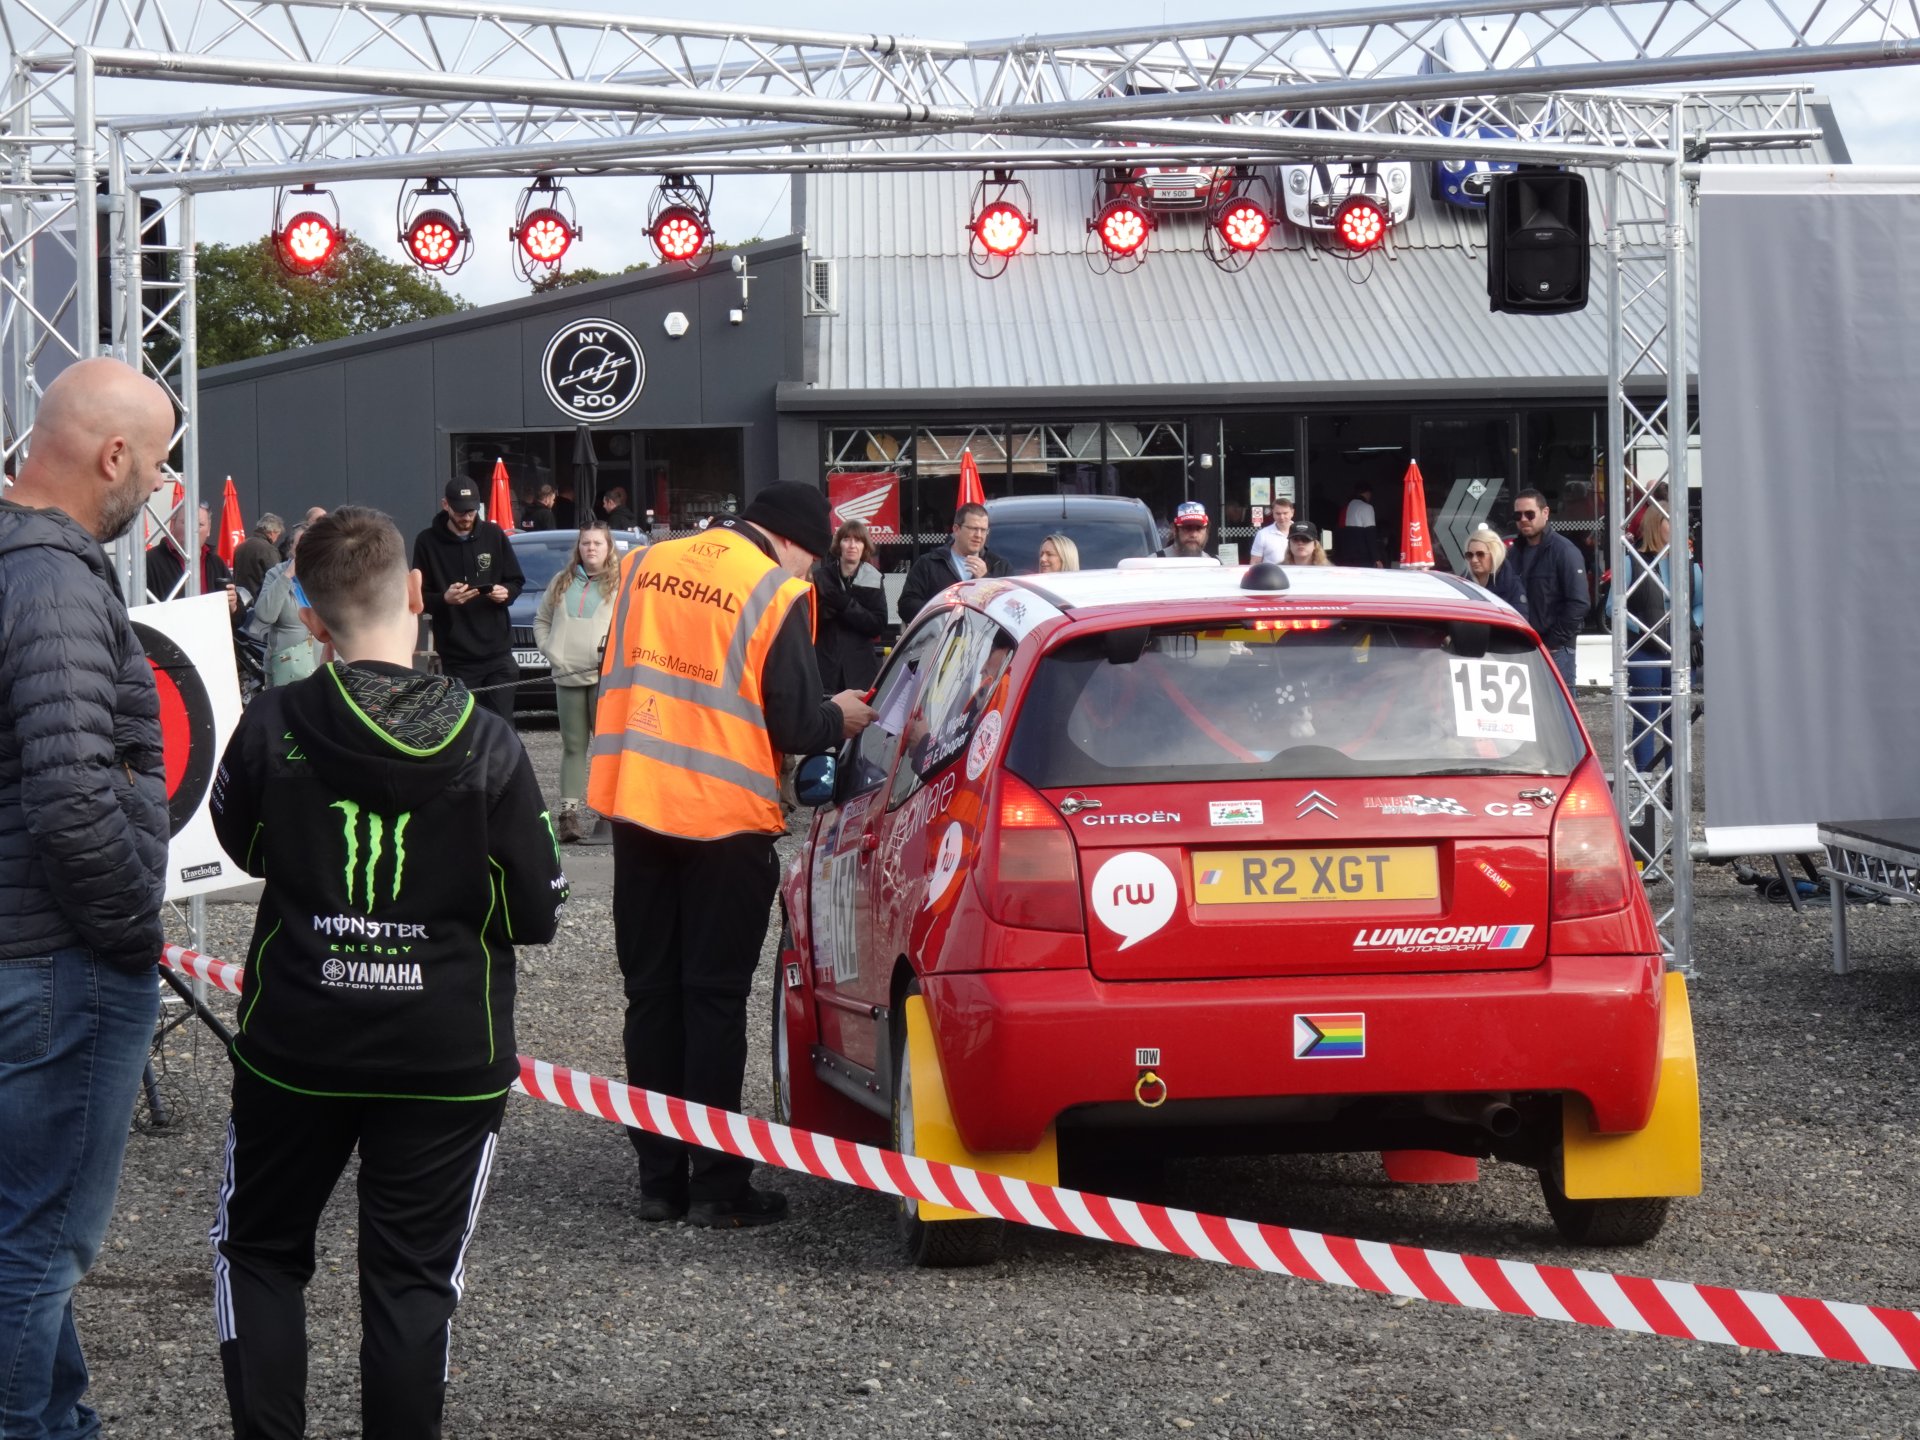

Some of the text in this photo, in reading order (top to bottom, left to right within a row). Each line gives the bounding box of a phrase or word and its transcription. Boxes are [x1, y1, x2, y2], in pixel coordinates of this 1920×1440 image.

[579, 332, 607, 343] NY
[573, 395, 616, 407] 500
[635, 572, 736, 614] MARSHAL
[1454, 663, 1530, 716] 152
[1484, 802, 1533, 816] C2
[1082, 811, 1181, 826] CITROËN
[182, 866, 220, 879] Travelodge
[1242, 855, 1390, 895] R2 XGT
[1113, 883, 1155, 906] rw
[313, 914, 429, 939] MONSTER
[1353, 926, 1498, 946] LUNICORN
[330, 944, 411, 955] ENERGY
[1394, 943, 1486, 953] MOTORSPORT
[346, 961, 422, 984] YAMAHA
[321, 980, 376, 990] FACTORY
[1138, 1050, 1158, 1064] TOW
